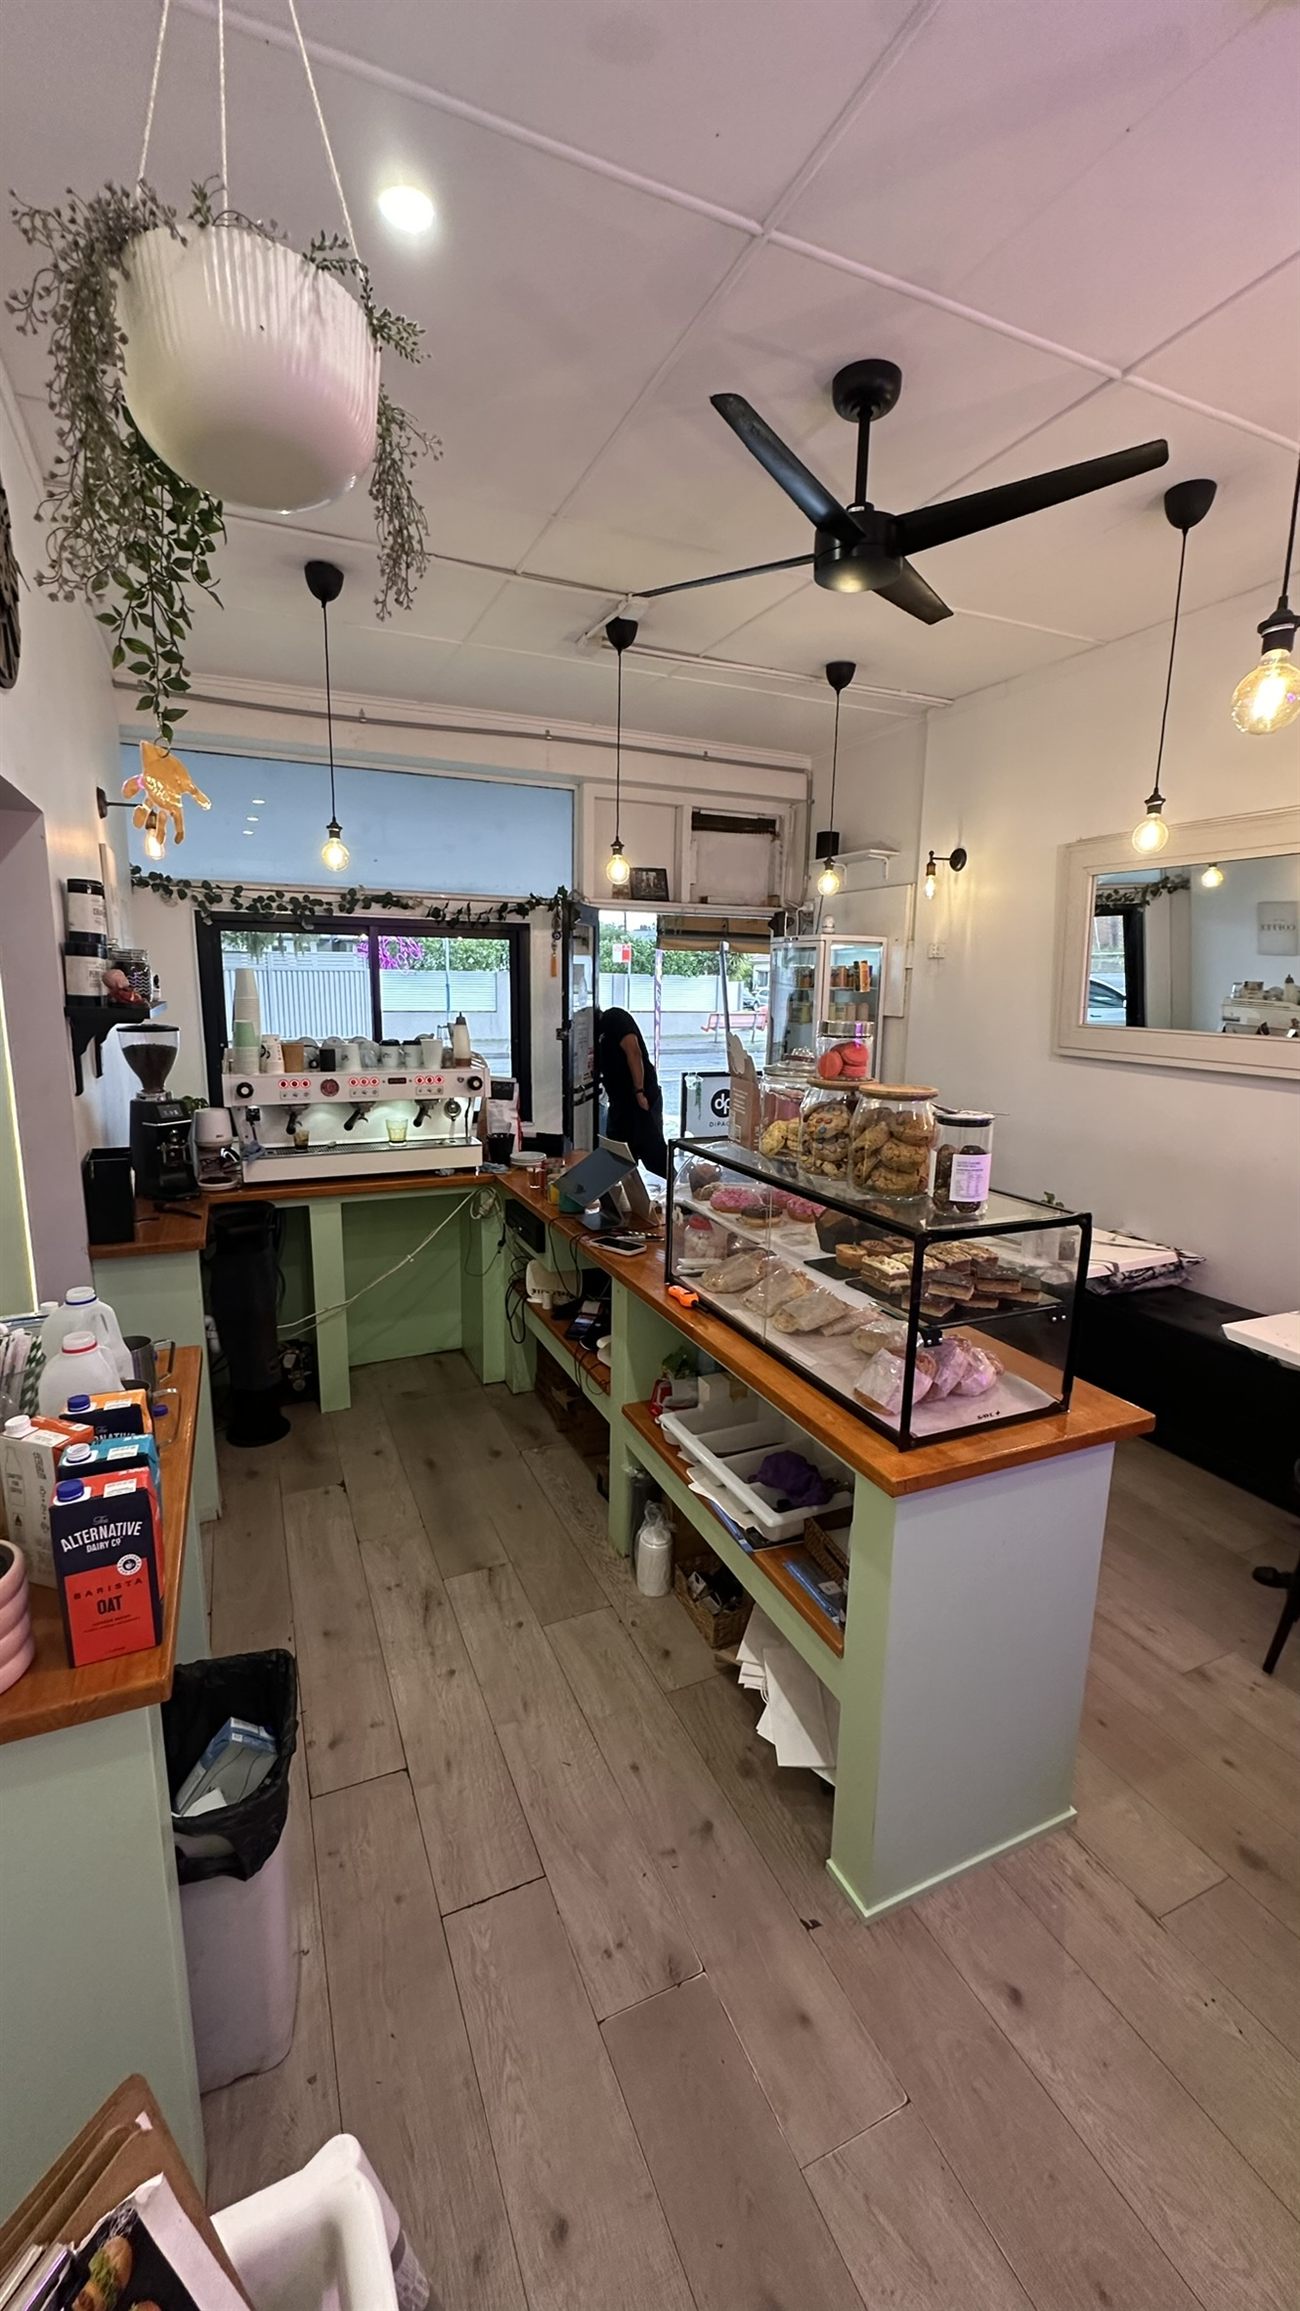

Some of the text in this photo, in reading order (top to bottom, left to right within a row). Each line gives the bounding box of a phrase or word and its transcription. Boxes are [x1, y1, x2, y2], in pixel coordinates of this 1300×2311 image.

[60, 1521, 143, 1553] ALTERNATIVE
[86, 1540, 109, 1553] DAIRY
[73, 1579, 143, 1600] BARISTA
[97, 1595, 122, 1615] OAT
